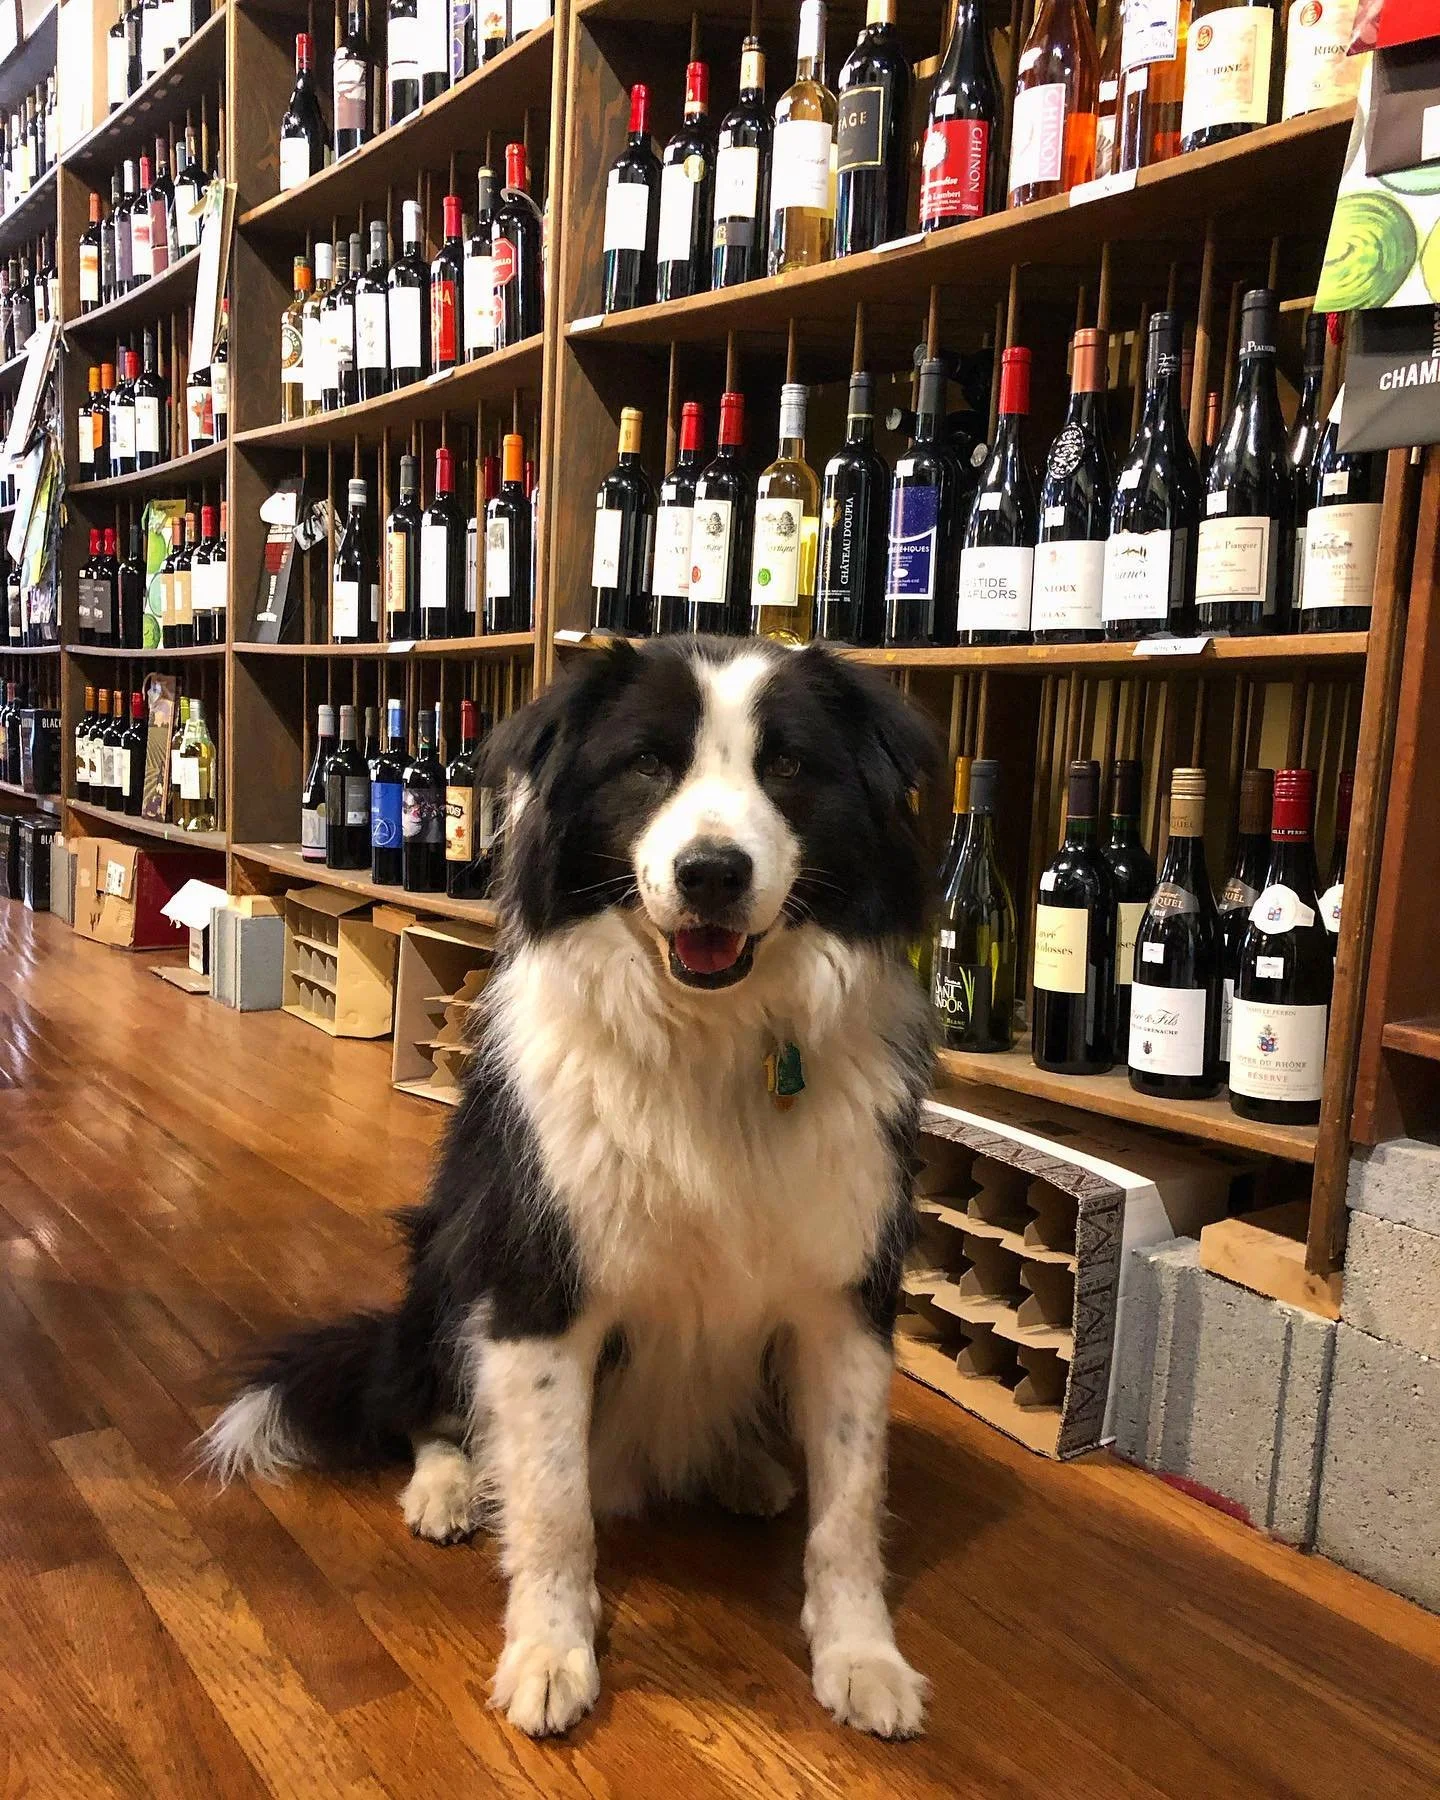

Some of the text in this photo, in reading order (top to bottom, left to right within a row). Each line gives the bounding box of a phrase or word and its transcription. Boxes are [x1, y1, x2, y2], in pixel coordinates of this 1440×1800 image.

[1040, 88, 1060, 178] CHINON
[969, 127, 983, 192] CHINON
[840, 539, 851, 585] CHÂTEAU
[1154, 1008, 1181, 1027] Fils
[1275, 1060, 1308, 1069] RHÔNE
